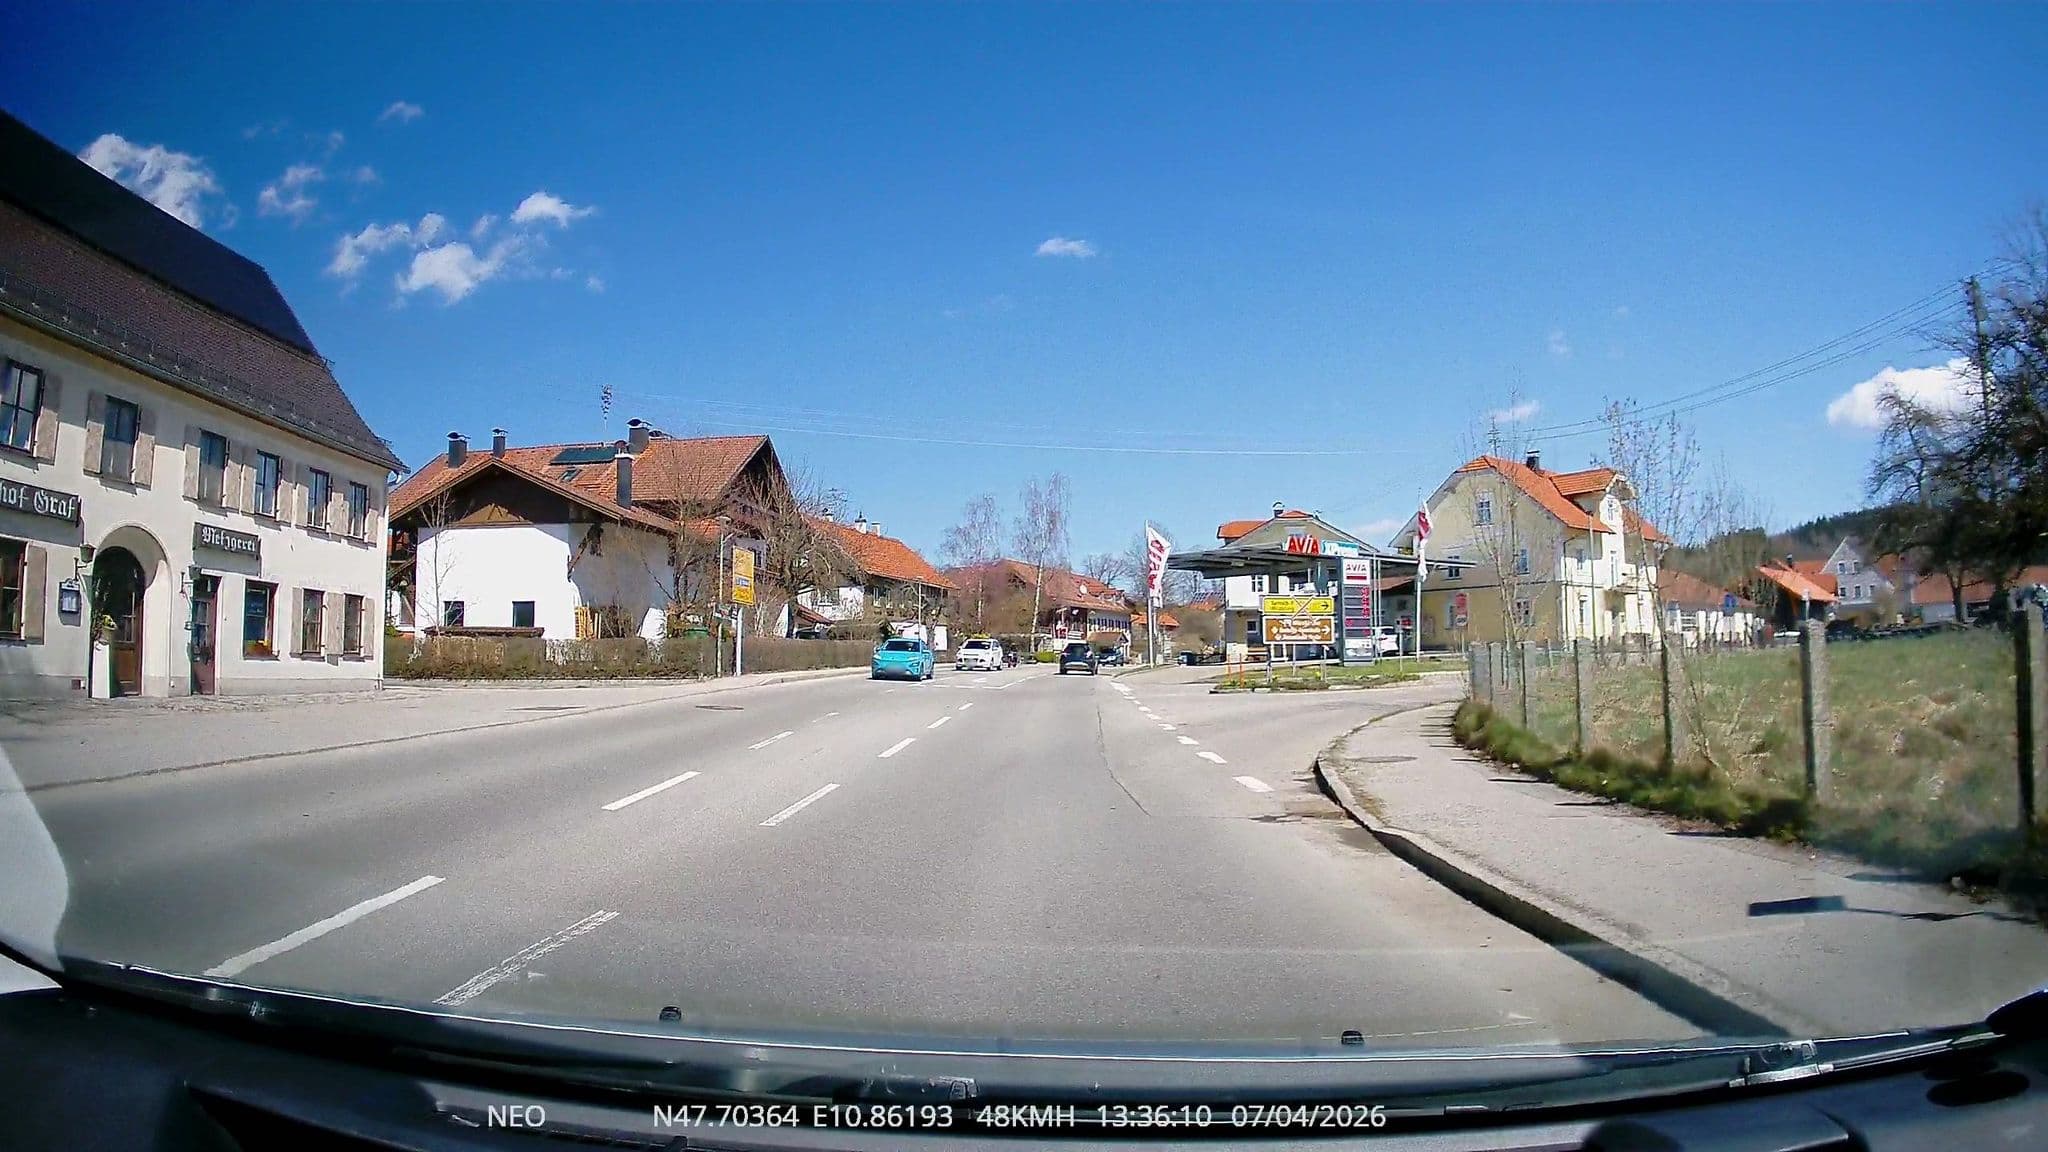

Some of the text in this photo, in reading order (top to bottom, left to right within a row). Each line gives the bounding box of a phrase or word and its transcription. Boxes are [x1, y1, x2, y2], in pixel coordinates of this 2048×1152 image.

[34, 490, 75, 519] Graf
[202, 526, 256, 551] Metzgerei
[1287, 534, 1321, 555] AVIA
[1345, 563, 1367, 572] AVIA
